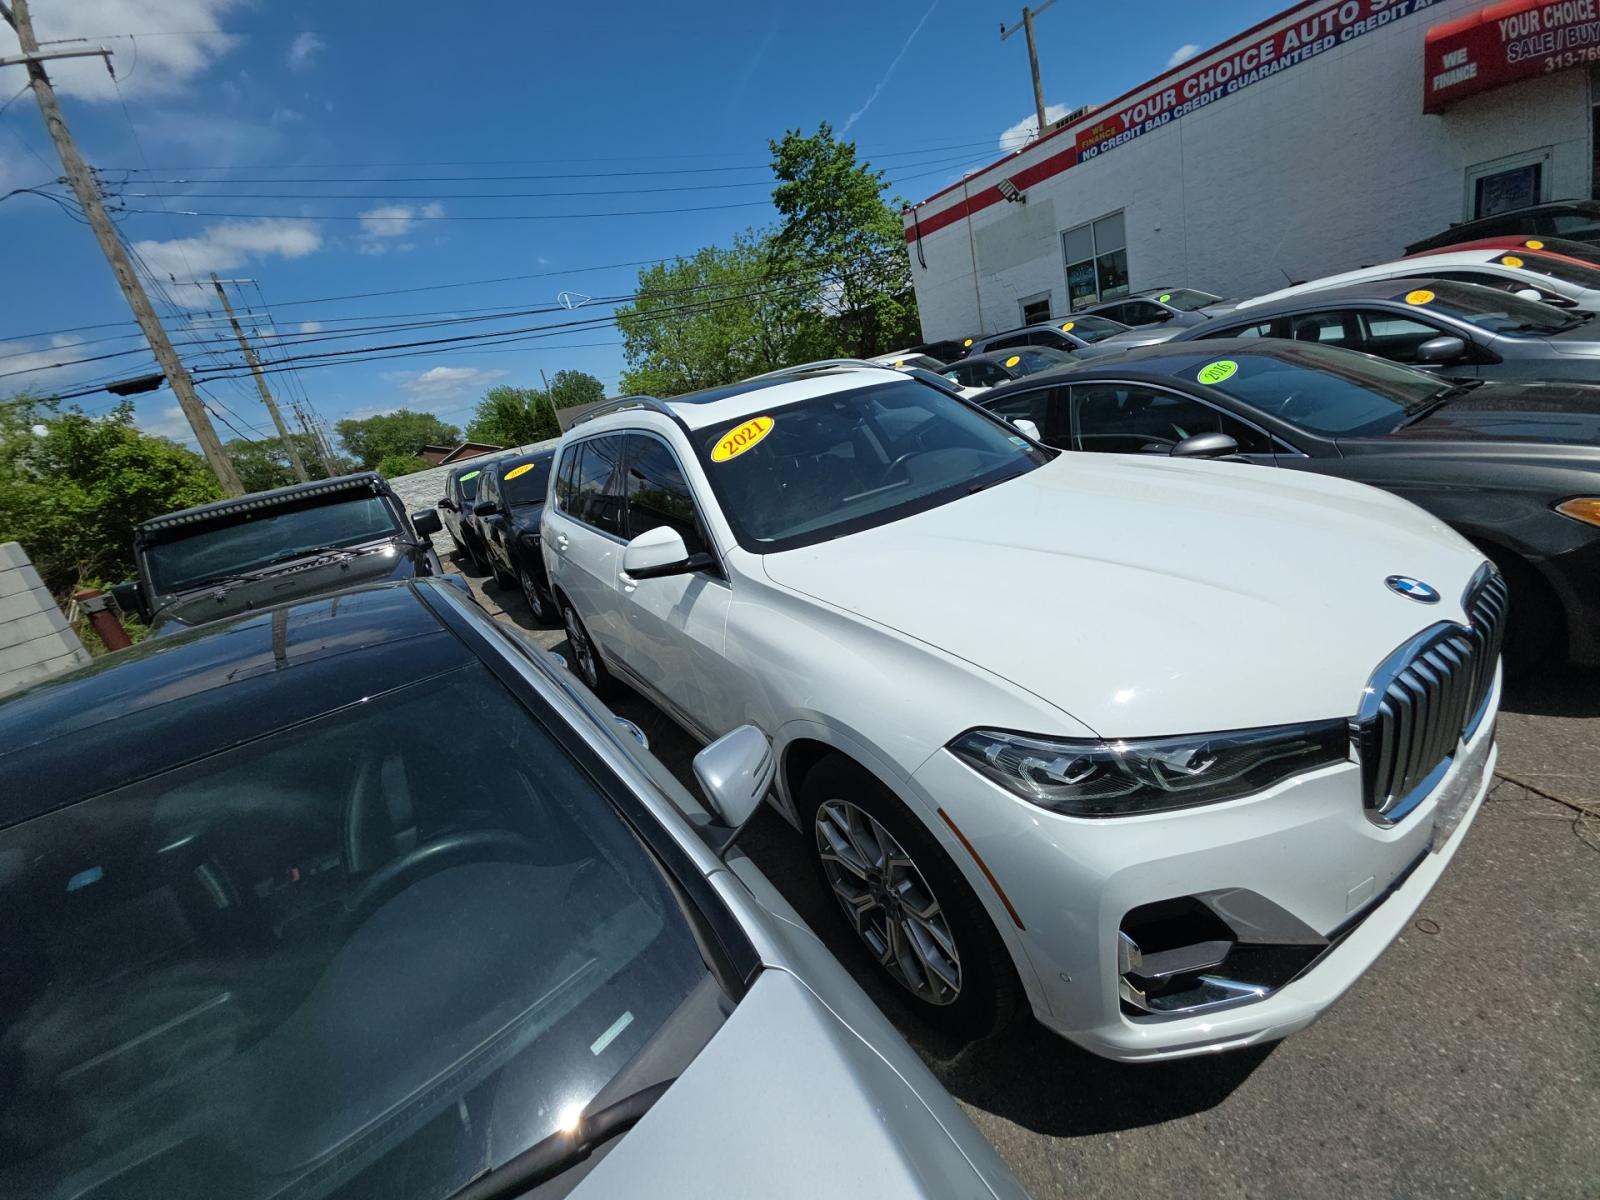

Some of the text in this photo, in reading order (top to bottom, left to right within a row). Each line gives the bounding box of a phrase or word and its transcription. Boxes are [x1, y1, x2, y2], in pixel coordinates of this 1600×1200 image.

[1499, 0, 1597, 41] YOUR CHOICE
[1120, 0, 1360, 129] YOUR CHOICE AUTO
[1442, 47, 1468, 69] WE
[1082, 146, 1099, 161] NO
[1100, 126, 1143, 152] CREDIT
[1145, 111, 1171, 131] BAD
[1173, 86, 1224, 118] CREDIT
[1227, 34, 1336, 93] GUARANTEED
[1341, 1, 1410, 41] CREDIT
[1432, 62, 1478, 92] FINANCE
[1081, 127, 1116, 148] FINANCE
[1204, 362, 1232, 381] 2016
[722, 421, 765, 456] 2021
